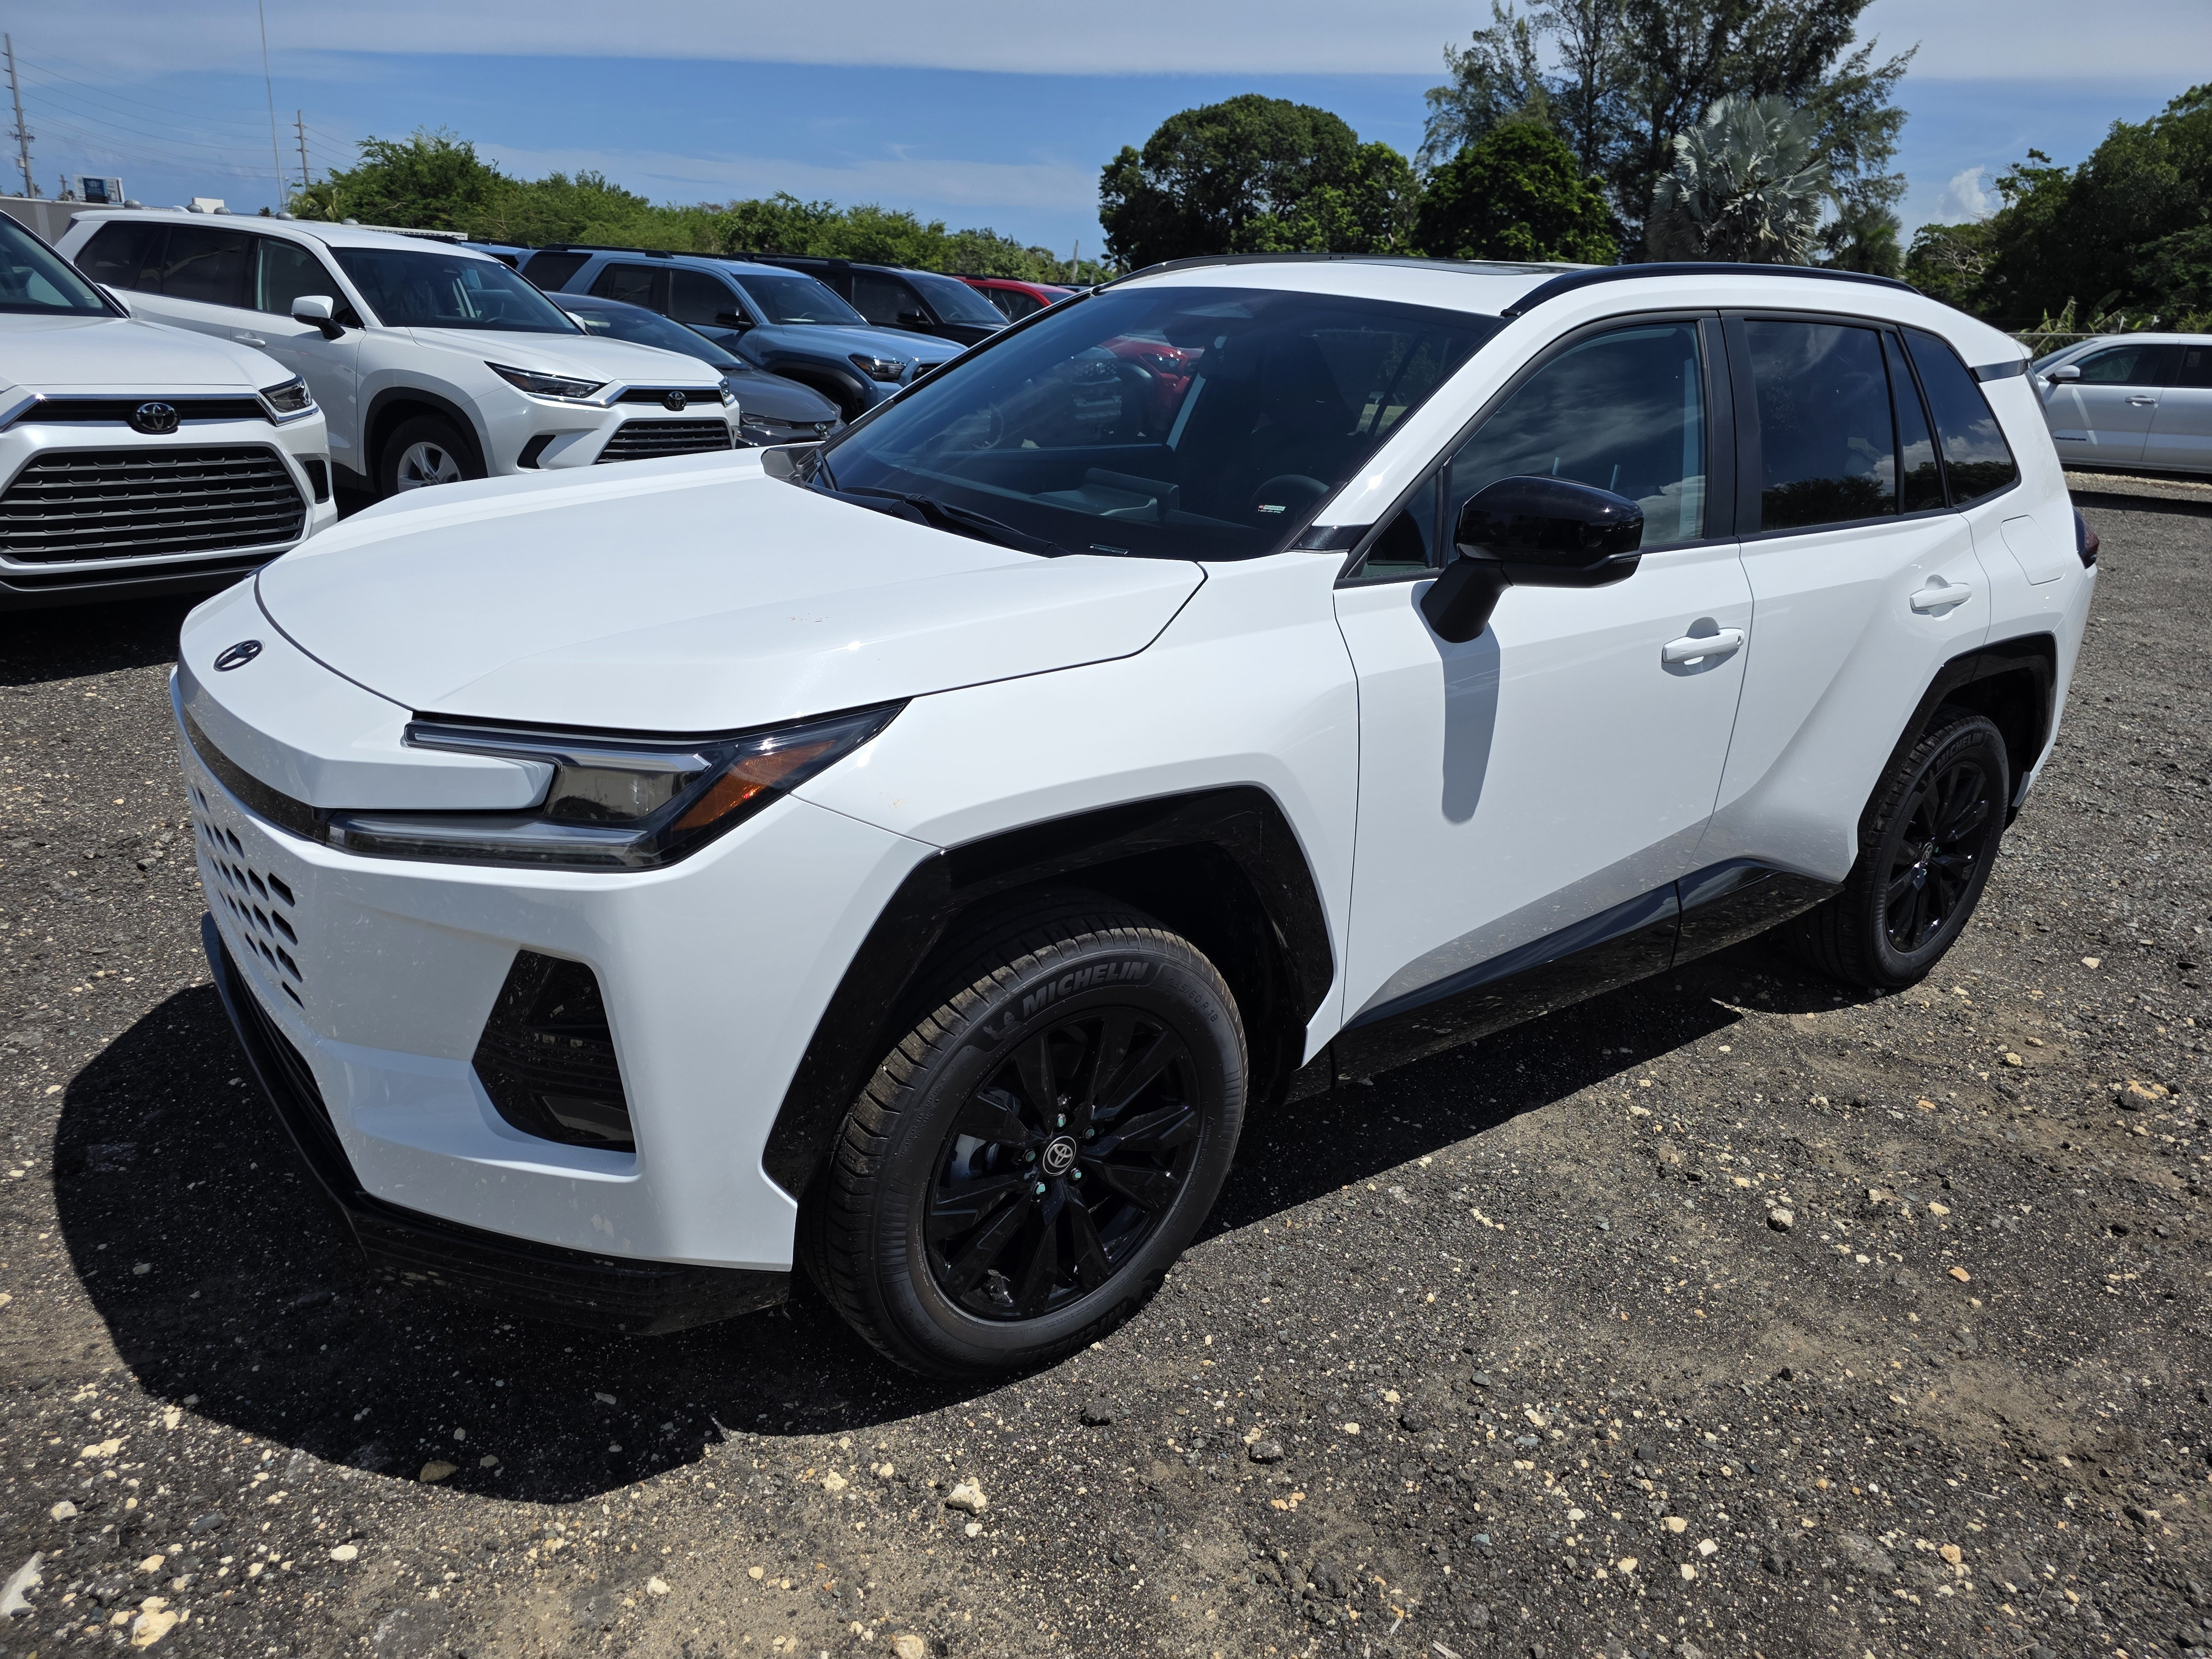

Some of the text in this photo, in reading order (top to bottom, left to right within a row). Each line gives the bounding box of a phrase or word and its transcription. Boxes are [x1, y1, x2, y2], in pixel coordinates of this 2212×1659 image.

[1936, 732, 1983, 773] MICHELIN
[1023, 961, 1149, 1017] MICHELIN
[1166, 977, 1202, 1003] 235/60
[1008, 1300, 1128, 1368] MICHELIN
